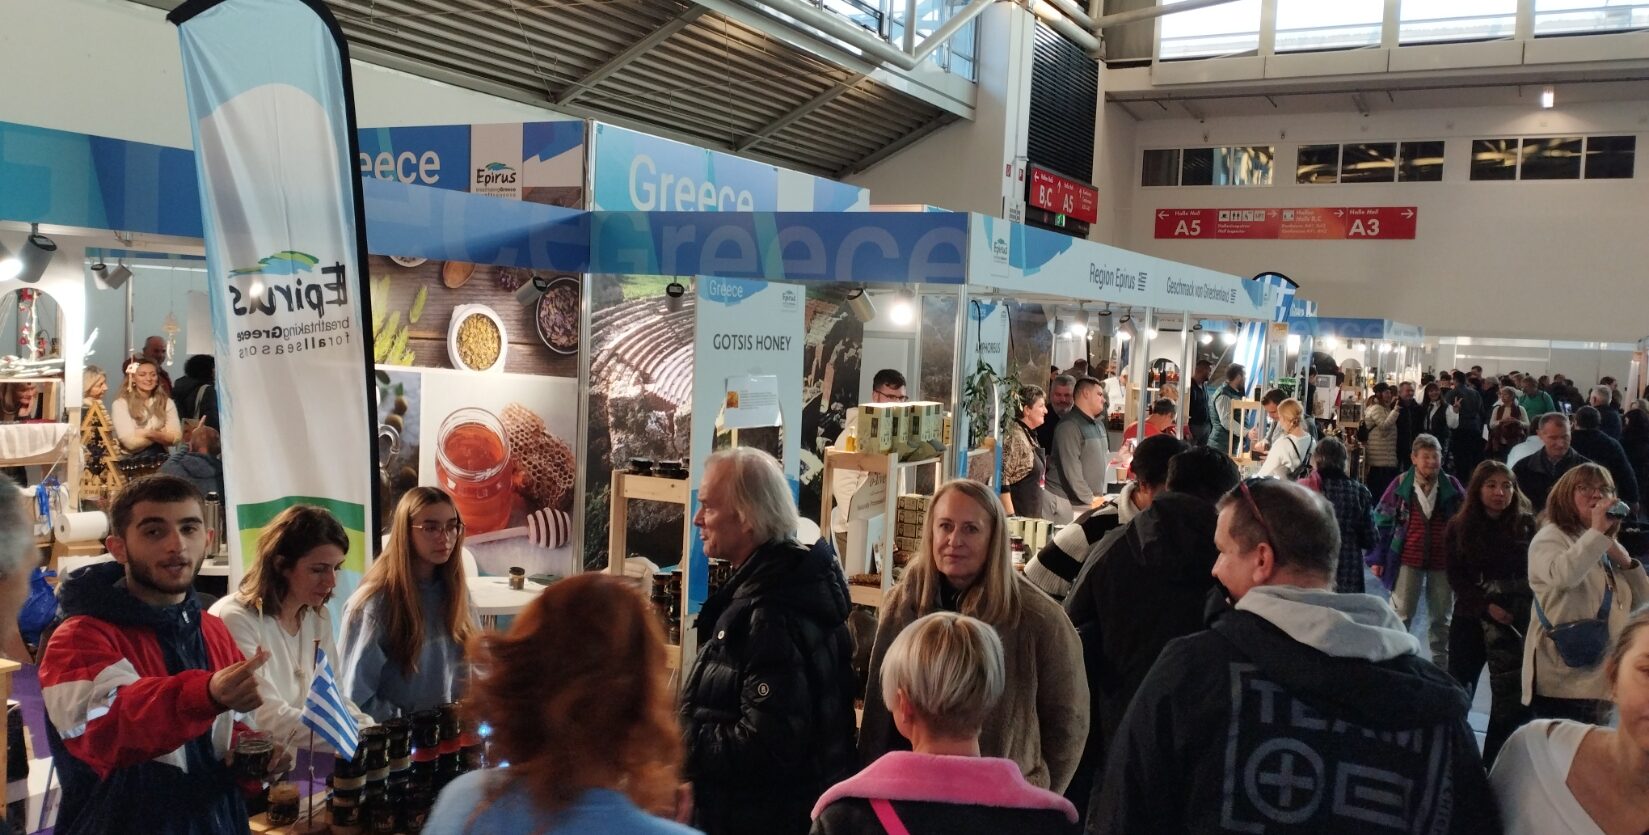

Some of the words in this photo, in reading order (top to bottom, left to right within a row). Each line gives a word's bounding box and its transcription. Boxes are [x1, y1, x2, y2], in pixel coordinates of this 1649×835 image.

[476, 168, 517, 187] Epirus
[628, 154, 753, 212] Greece
[1062, 193, 1074, 213] A5
[1174, 219, 1201, 236] A5
[1348, 219, 1380, 236] A3
[1089, 262, 1115, 290] Region
[1115, 267, 1136, 293] Epirus
[1166, 276, 1195, 297] Geschmack
[709, 279, 744, 298] Greece
[713, 333, 753, 351] GOTSIS
[755, 335, 792, 352] HONEY
